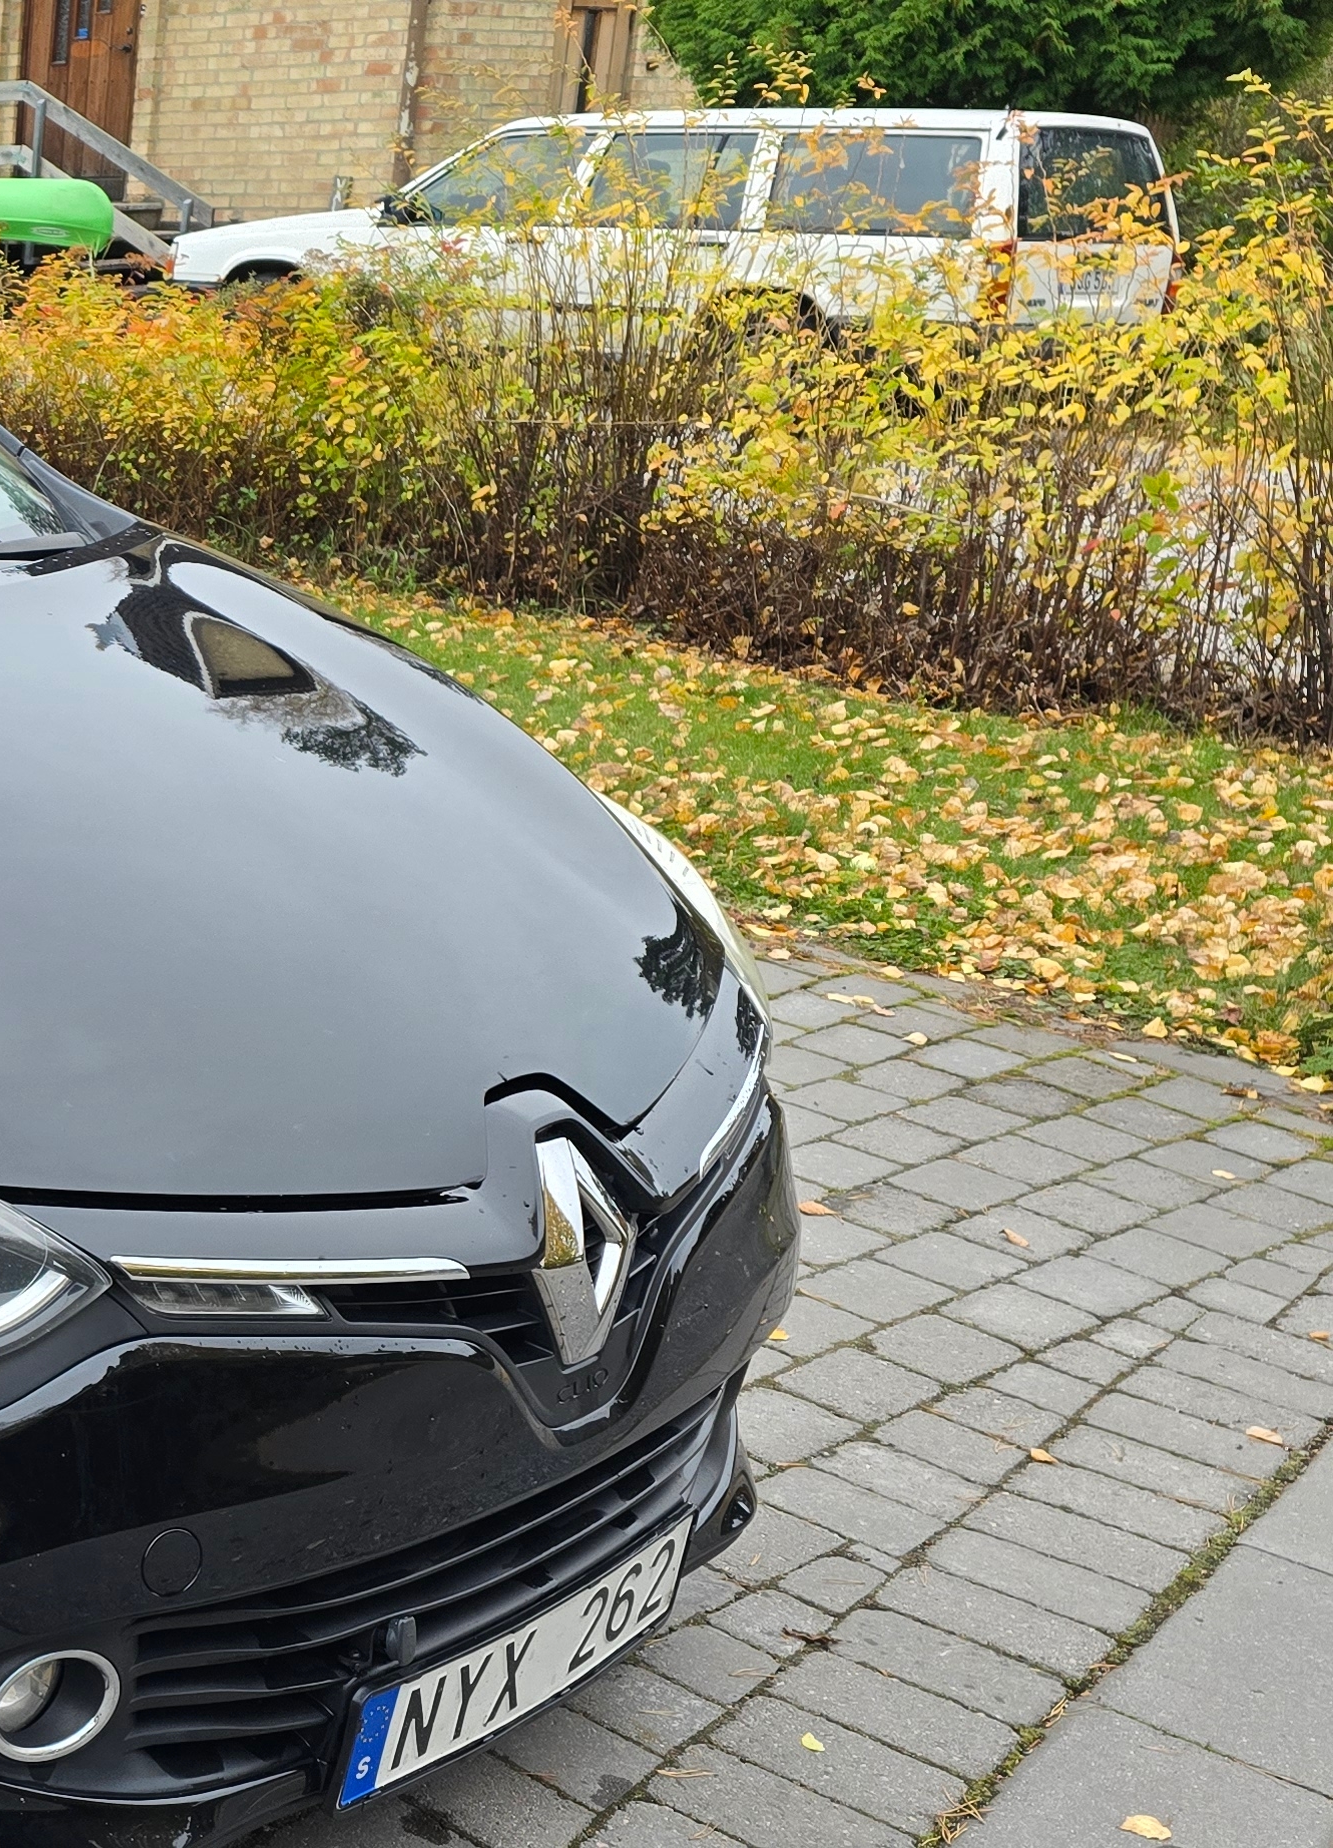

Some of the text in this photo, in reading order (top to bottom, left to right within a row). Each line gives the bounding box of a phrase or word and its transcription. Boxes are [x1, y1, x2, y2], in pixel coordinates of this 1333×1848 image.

[556, 1367, 610, 1405] CLIO
[390, 1539, 676, 1771] NYX 262
[355, 1756, 372, 1780] S
